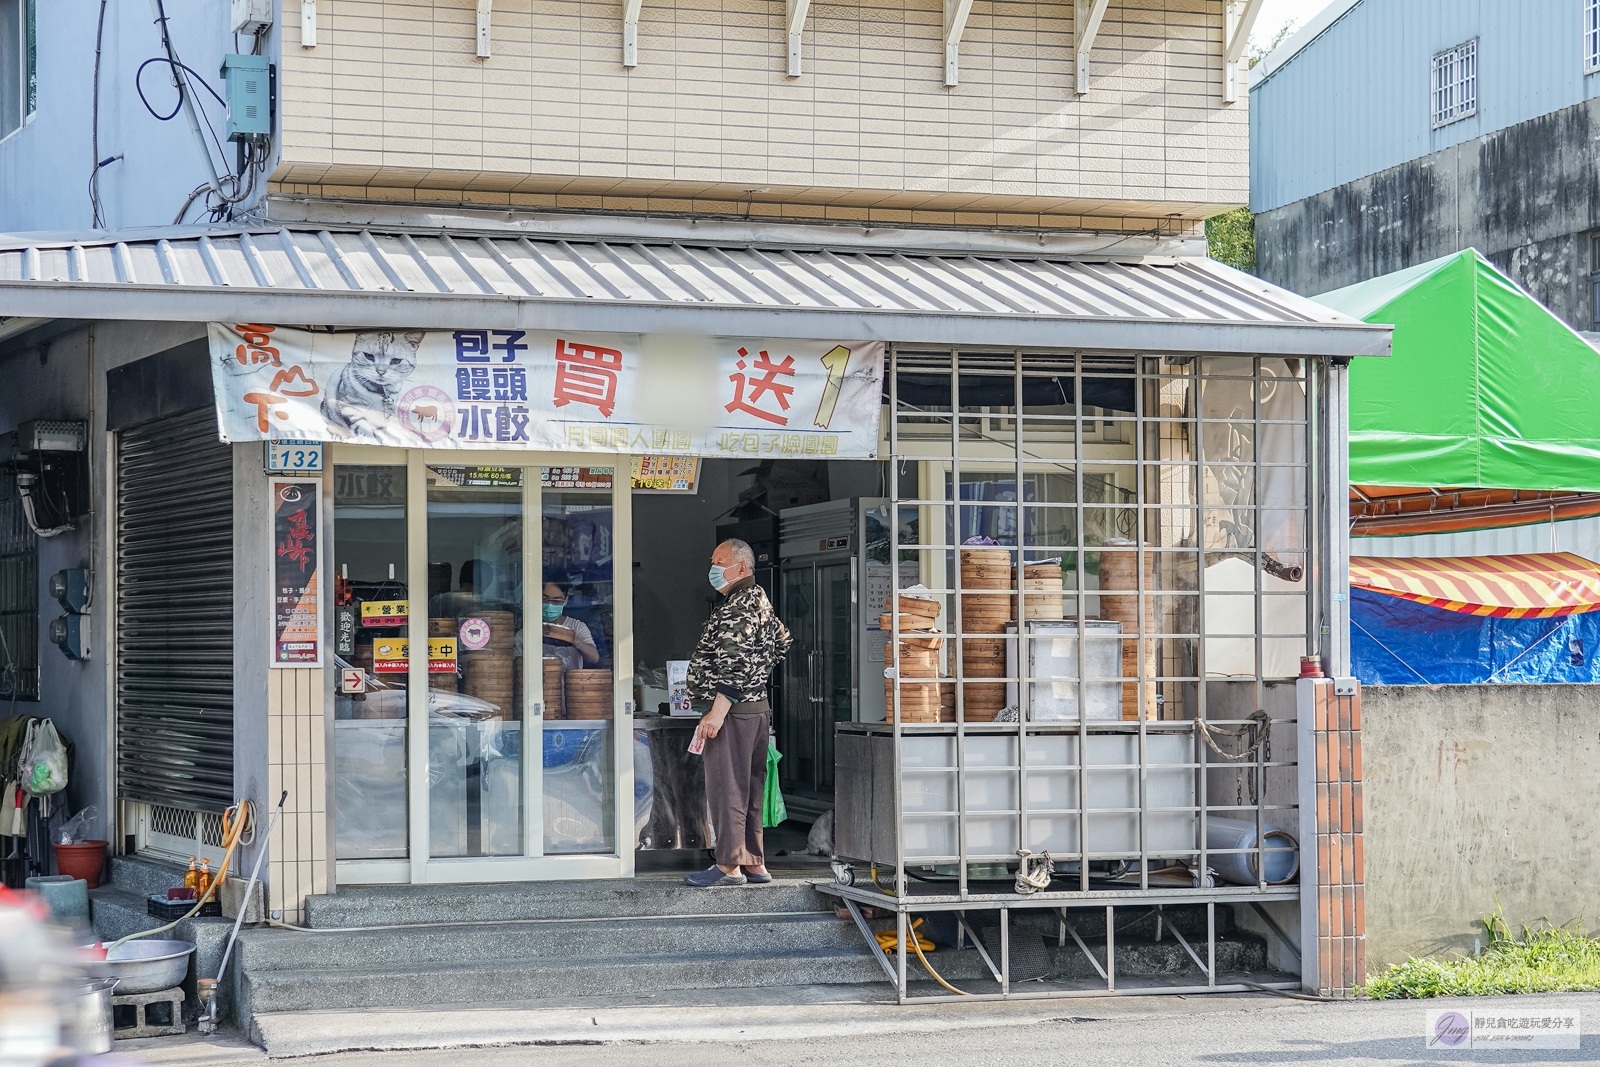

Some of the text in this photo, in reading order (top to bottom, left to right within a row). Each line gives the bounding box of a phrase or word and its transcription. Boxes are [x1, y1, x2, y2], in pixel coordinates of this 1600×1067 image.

[453, 331, 528, 362] 包子
[456, 368, 528, 401] 饅頭
[552, 338, 623, 418] 買
[458, 405, 530, 441] 水餃
[281, 450, 319, 467] 132
[339, 611, 351, 652] 歡迎光臨
